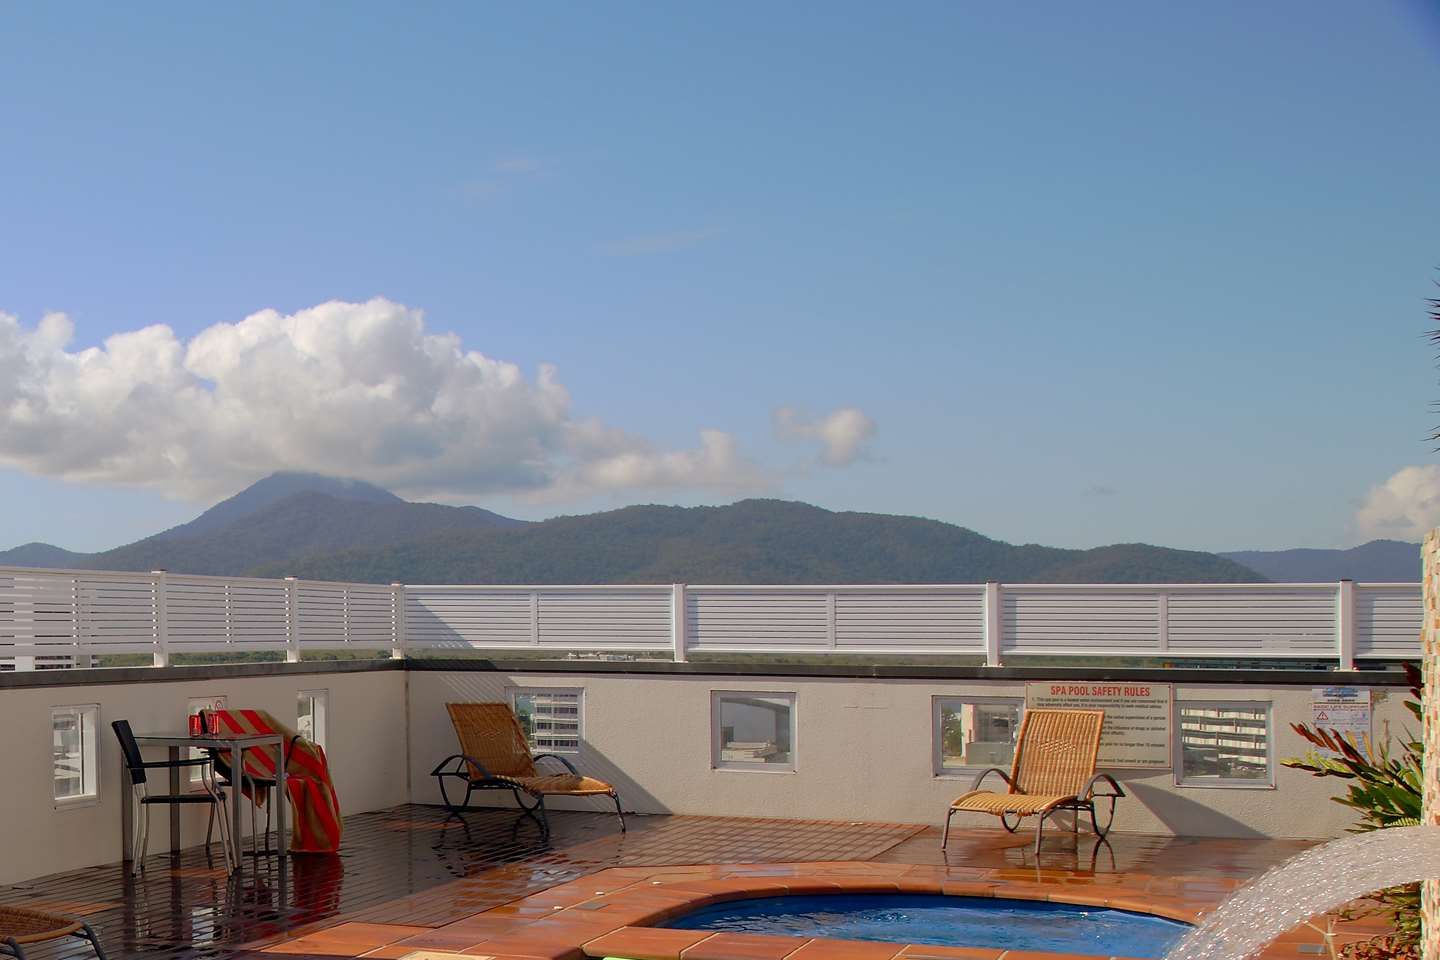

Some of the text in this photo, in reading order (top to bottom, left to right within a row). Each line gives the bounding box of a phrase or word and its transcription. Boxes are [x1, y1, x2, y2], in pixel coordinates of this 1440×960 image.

[1050, 685, 1150, 697] SPA POOL SAFETY RULES
